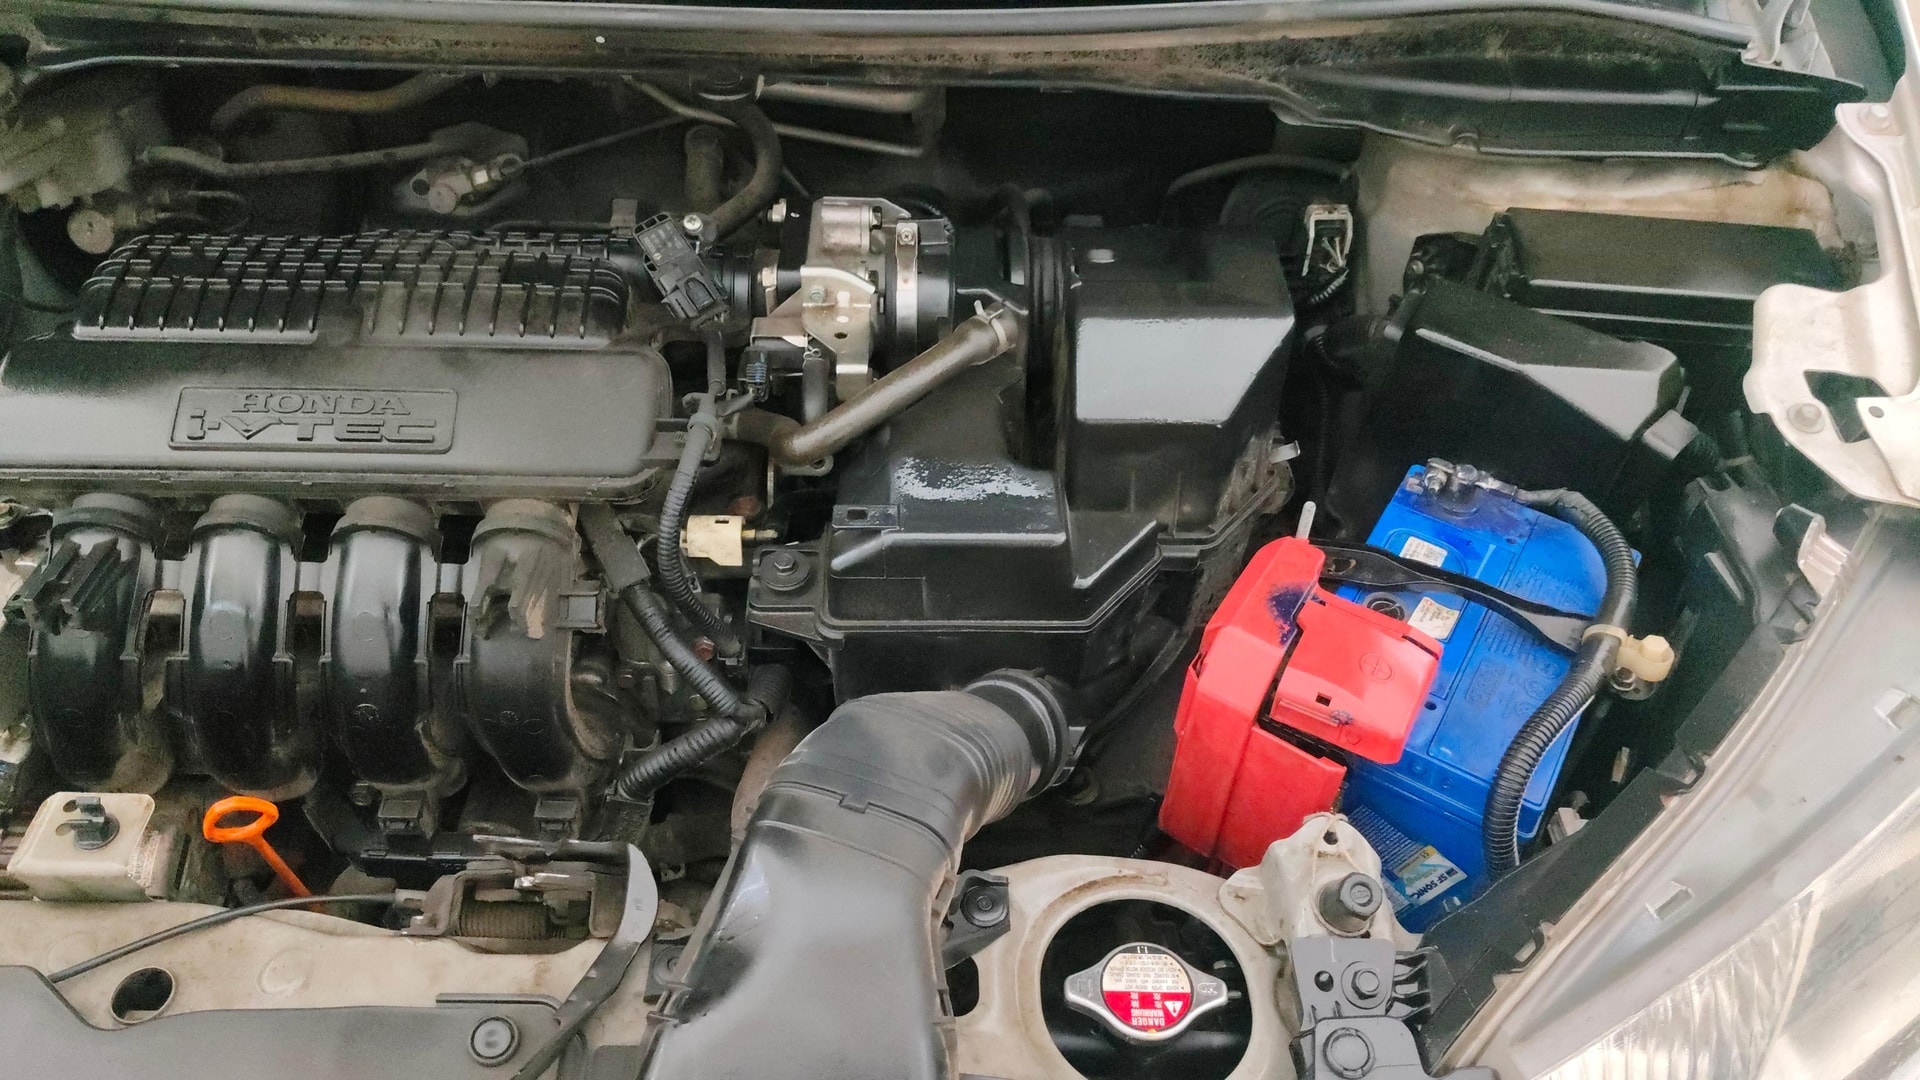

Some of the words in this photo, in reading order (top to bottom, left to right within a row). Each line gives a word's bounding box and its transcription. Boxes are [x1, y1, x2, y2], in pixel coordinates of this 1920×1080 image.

[231, 392, 411, 415] HONDA
[1437, 873, 1449, 885] SF
[1137, 946, 1149, 954] 1.1
[1131, 1017, 1166, 1027] DANGER
